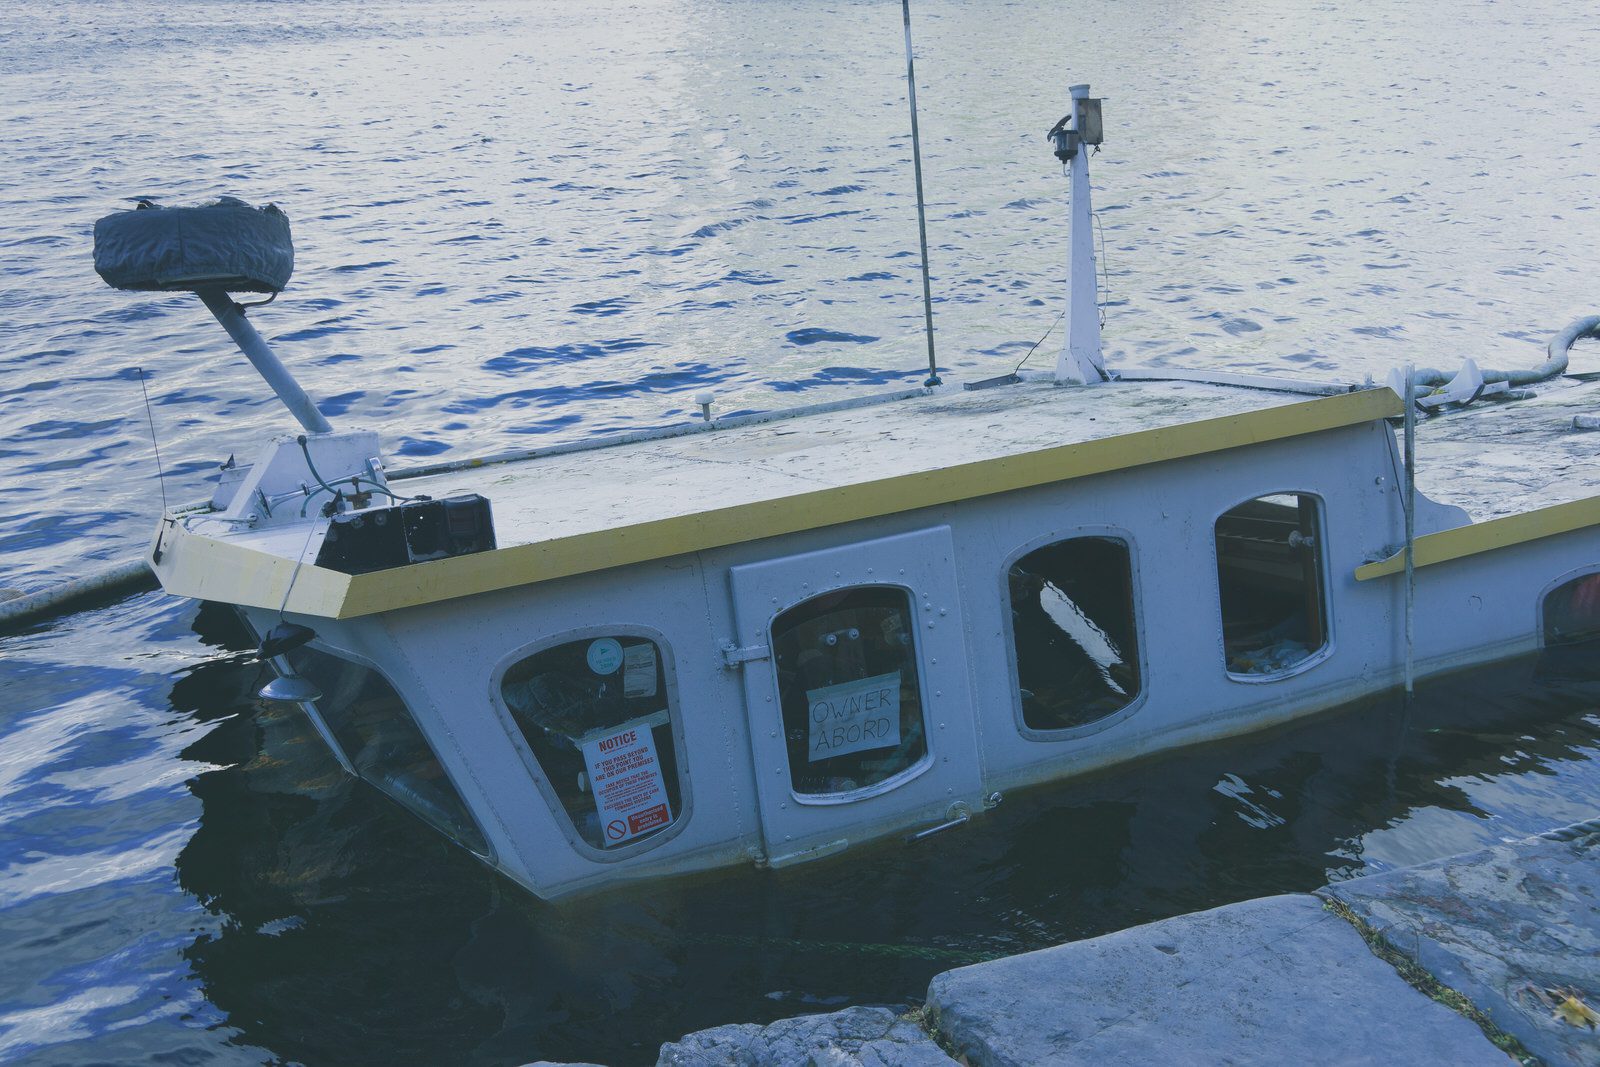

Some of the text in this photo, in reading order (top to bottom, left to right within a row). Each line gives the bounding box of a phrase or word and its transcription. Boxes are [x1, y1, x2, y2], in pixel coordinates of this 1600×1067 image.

[813, 688, 891, 723] OWNER
[598, 730, 637, 752] NOTICE
[815, 718, 891, 750] ABORD
[601, 758, 612, 766] YOU
[613, 754, 627, 762] PASS
[627, 746, 648, 757] BEYOND
[603, 764, 615, 773] THIS
[616, 759, 632, 768] POINT
[595, 756, 654, 781] ARE ON OUR PREMISES
